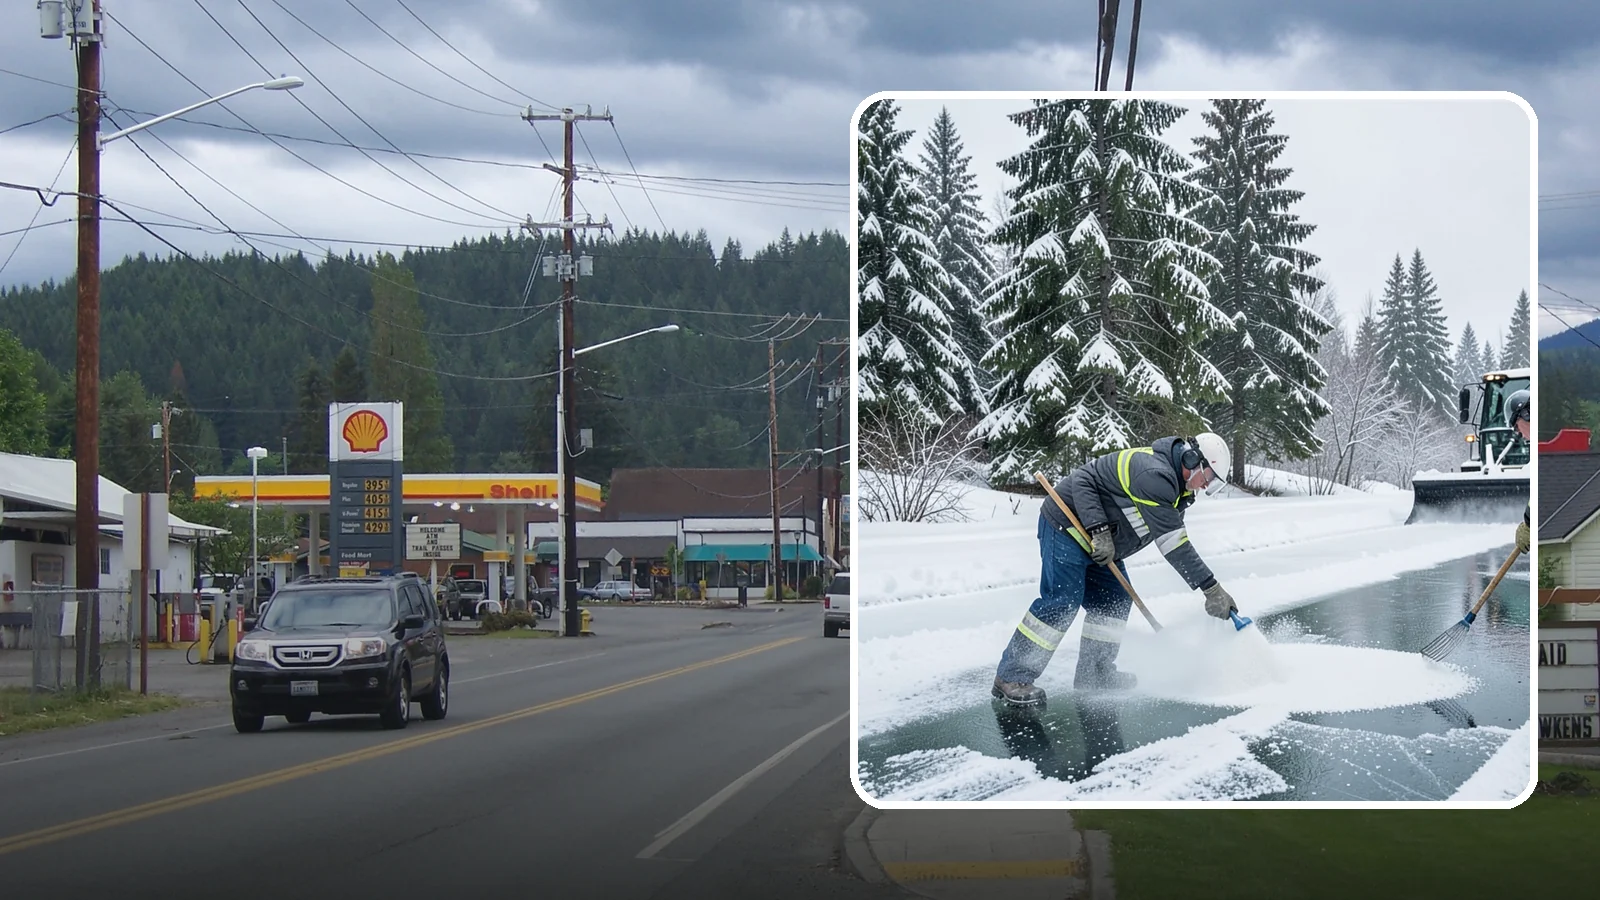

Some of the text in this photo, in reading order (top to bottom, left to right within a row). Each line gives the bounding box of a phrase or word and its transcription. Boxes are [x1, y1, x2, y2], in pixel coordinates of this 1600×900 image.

[366, 480, 383, 490] 395
[490, 484, 547, 498] Shell
[366, 494, 383, 504] 405
[366, 508, 383, 518] 415
[366, 522, 383, 532] 429
